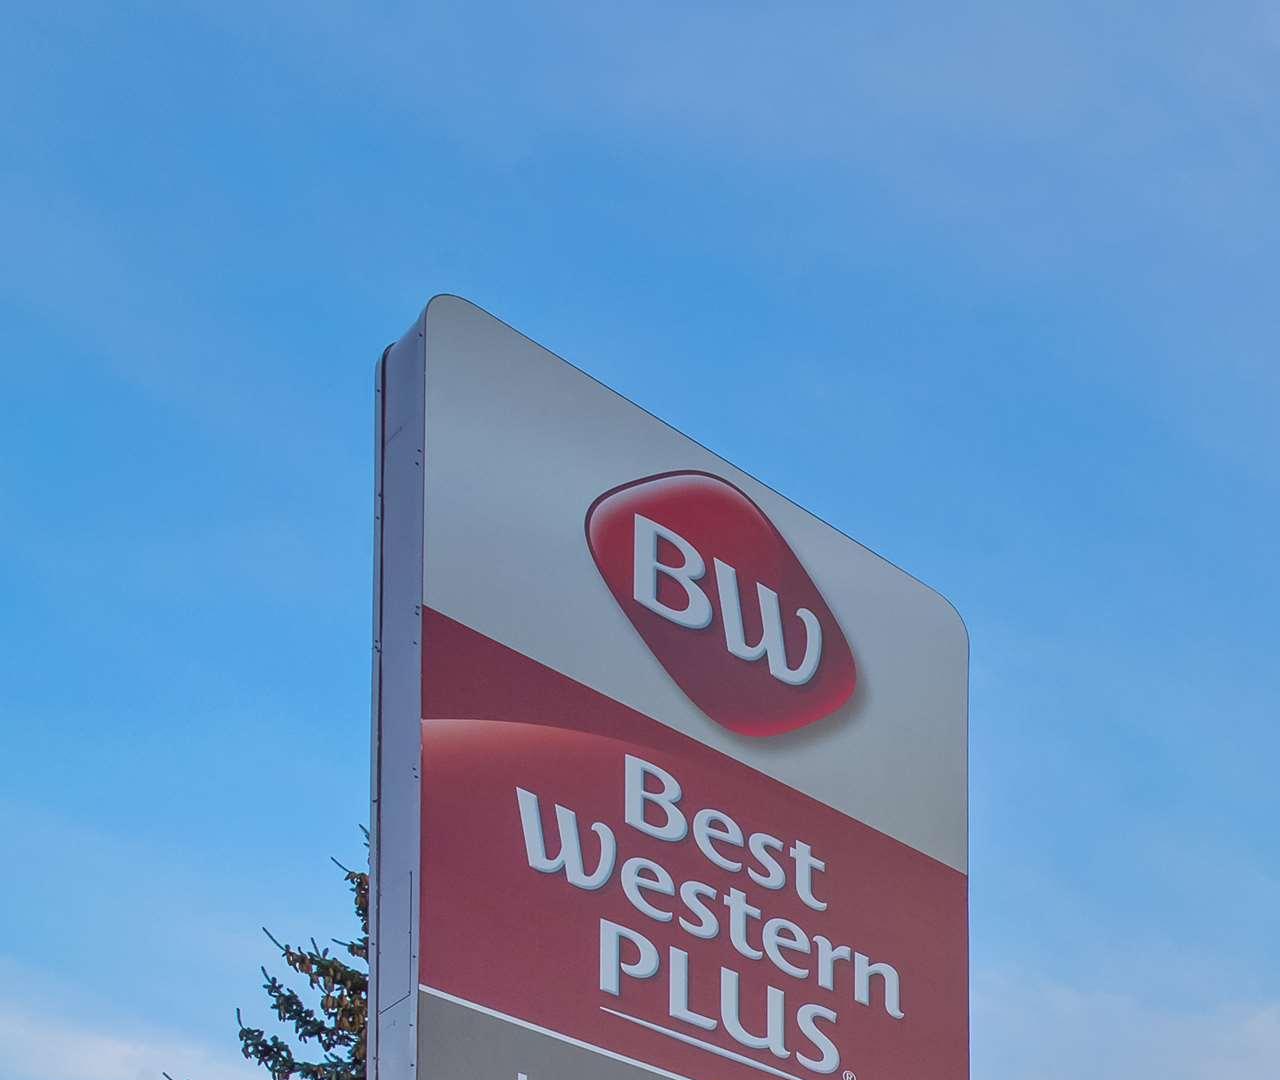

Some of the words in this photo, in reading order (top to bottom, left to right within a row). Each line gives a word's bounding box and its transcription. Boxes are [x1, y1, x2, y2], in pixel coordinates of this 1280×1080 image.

[633, 512, 823, 686] BW
[515, 785, 905, 1019] Western
[624, 753, 828, 912] Best
[599, 917, 841, 1075] PLUS
